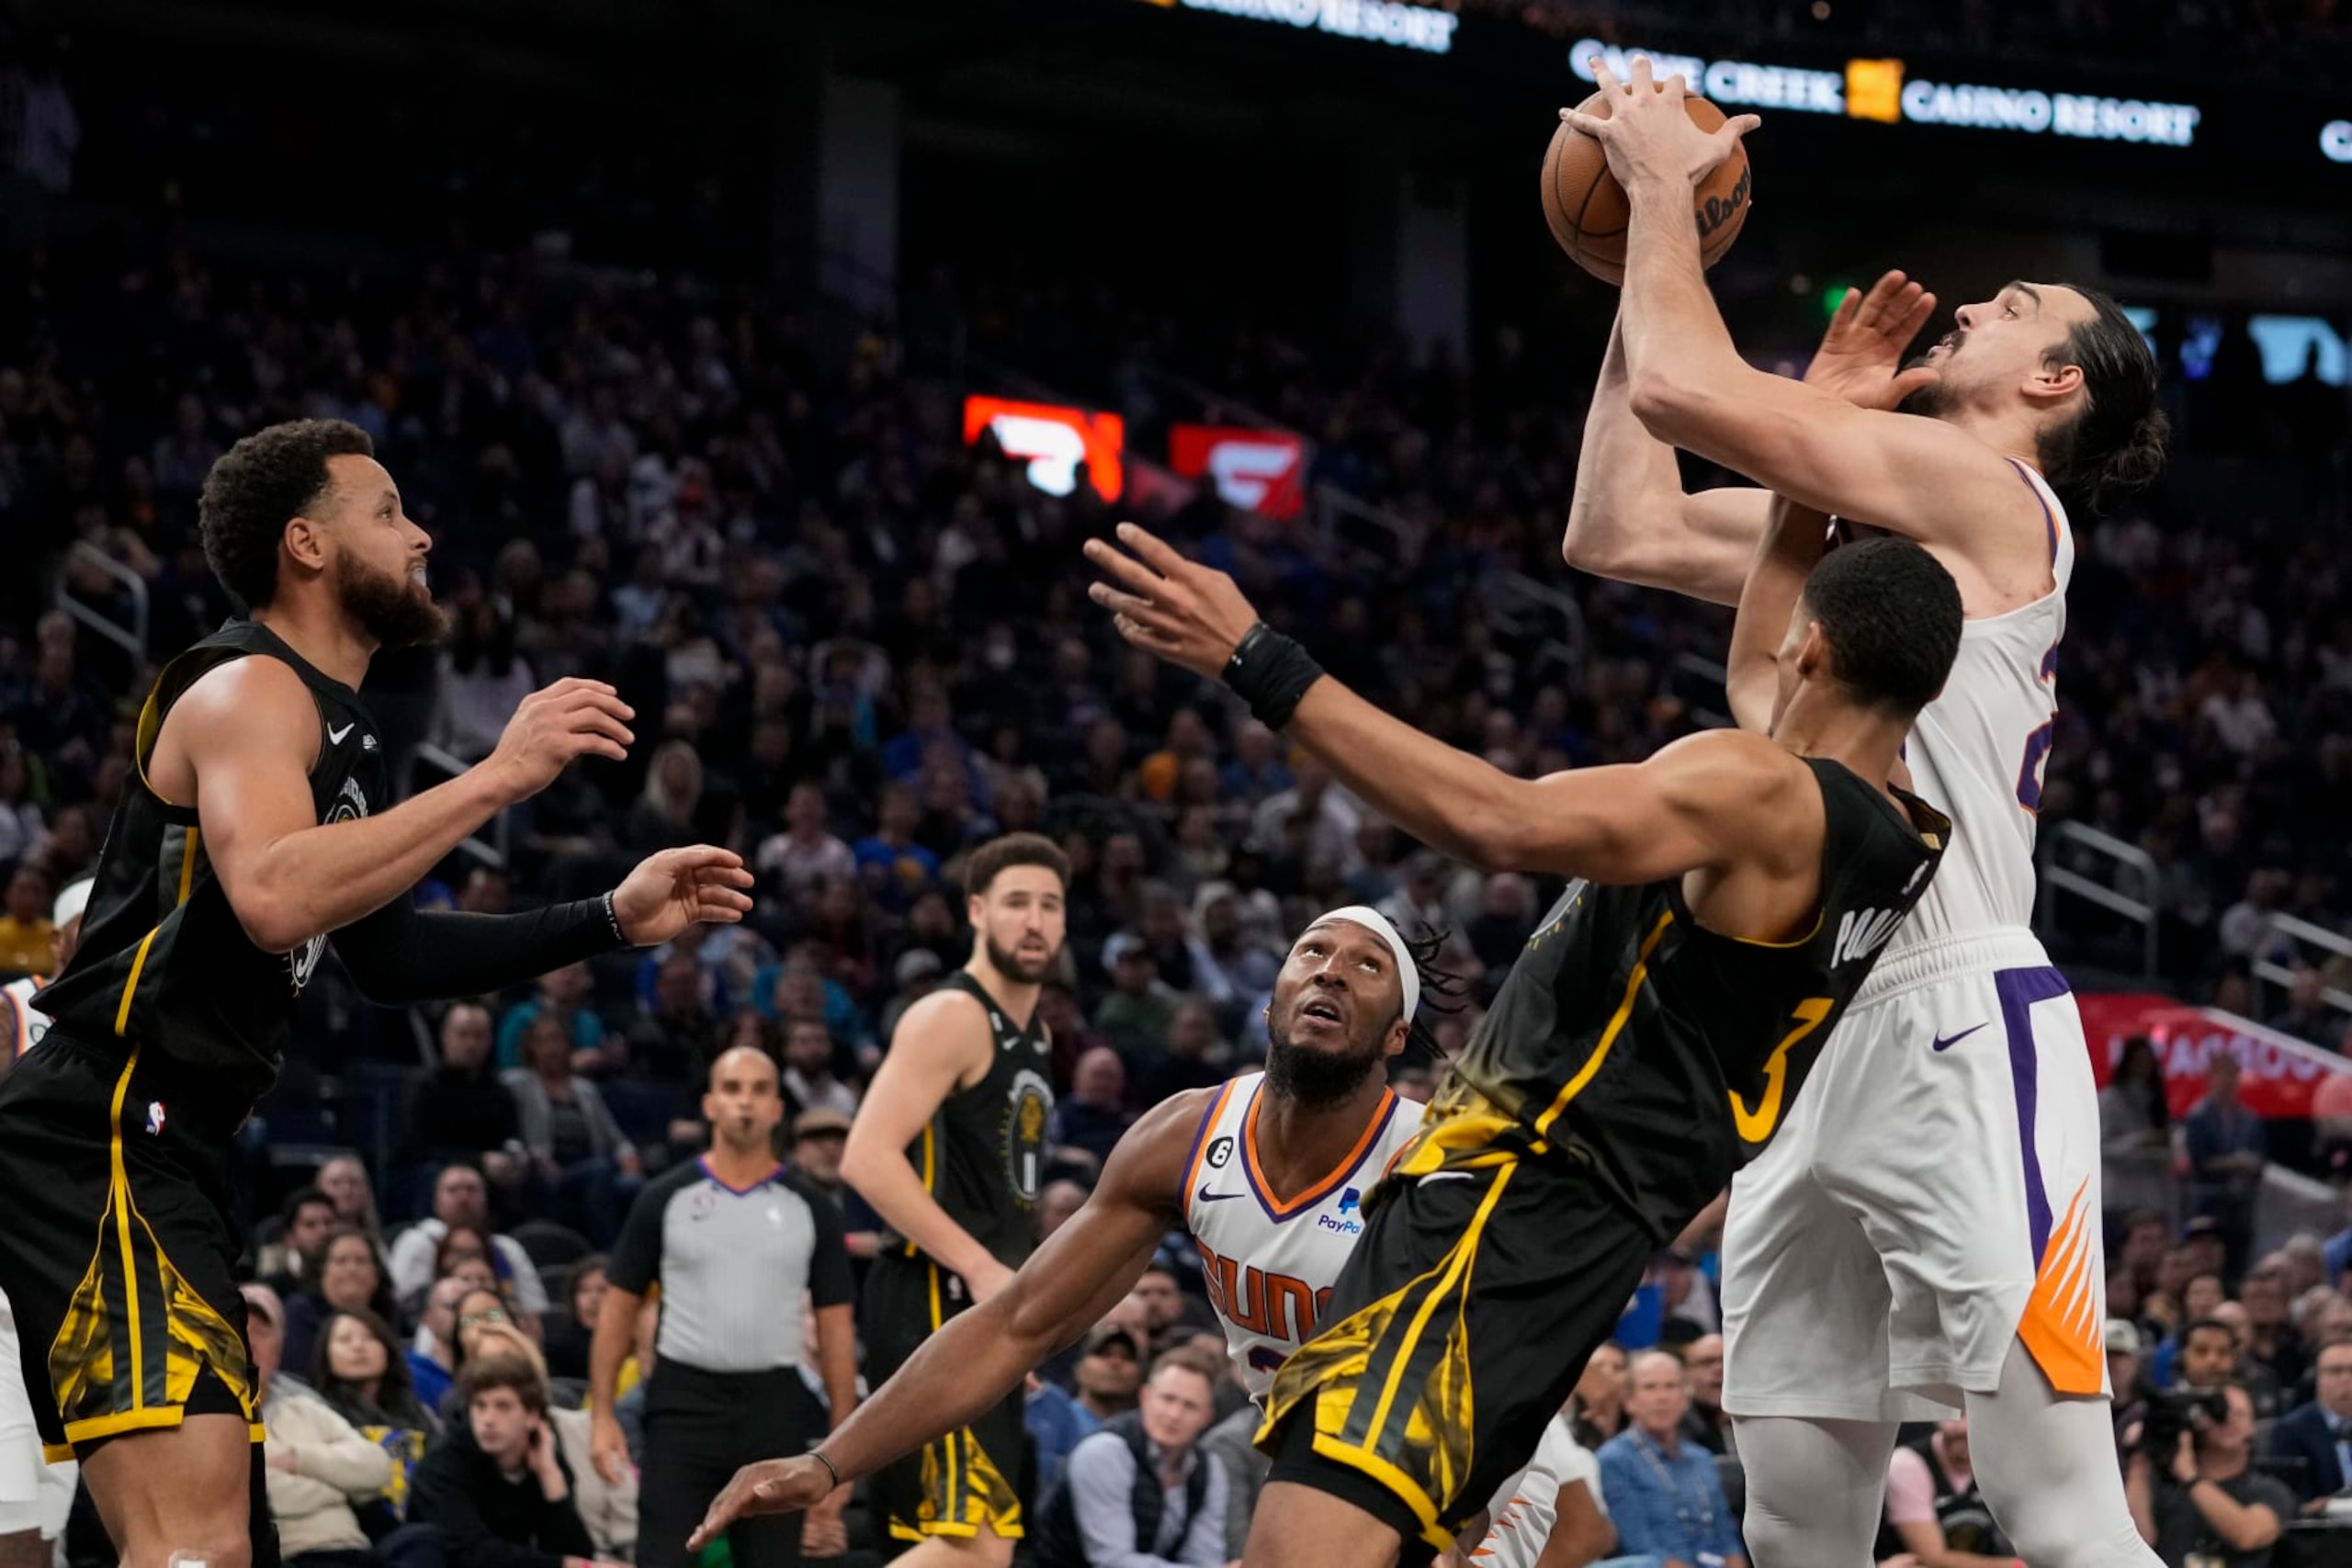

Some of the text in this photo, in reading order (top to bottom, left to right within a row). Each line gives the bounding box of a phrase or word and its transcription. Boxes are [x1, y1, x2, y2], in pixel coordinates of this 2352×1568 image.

[1706, 61, 1845, 113] CREEK
[1902, 80, 2052, 132] CASINO
[2052, 93, 2200, 146] RESORT
[1728, 998, 1835, 1143] 3
[1210, 1141, 1229, 1166] 6
[1196, 1240, 1332, 1345] SUN
